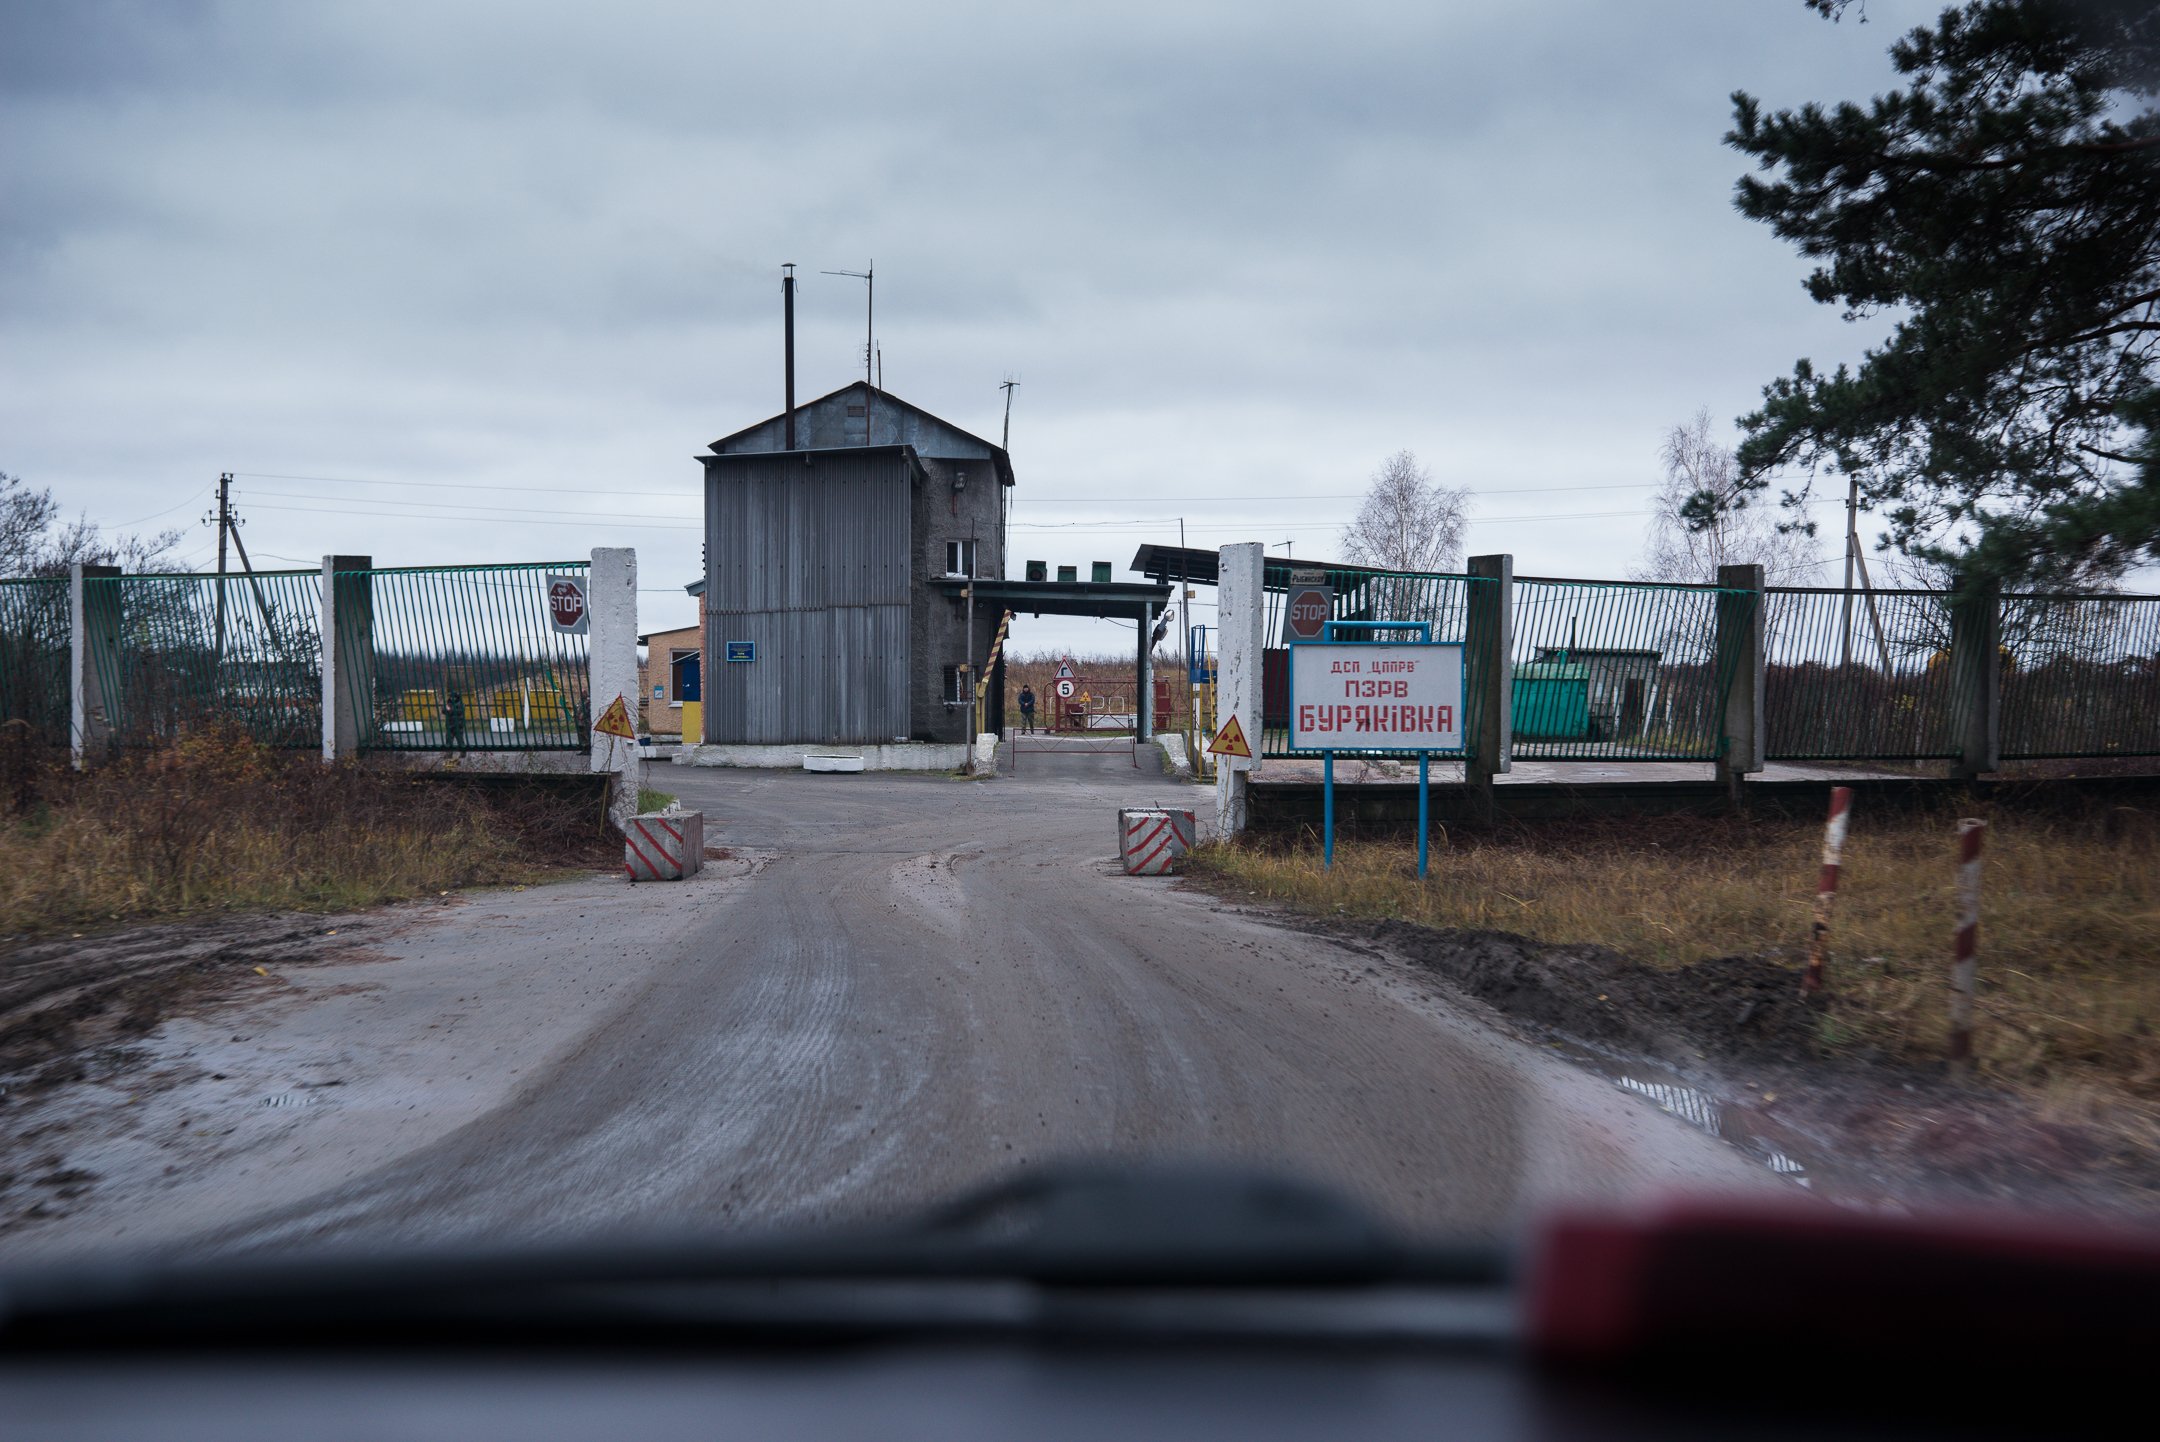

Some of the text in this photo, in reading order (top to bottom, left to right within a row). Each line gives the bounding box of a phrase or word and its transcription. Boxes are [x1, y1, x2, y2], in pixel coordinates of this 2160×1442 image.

[551, 595, 582, 612] STOP
[1292, 604, 1328, 620] STOP
[1331, 661, 1360, 674] ДСП
[1062, 684, 1070, 695] 5
[1345, 680, 1408, 698] ПЗРВ
[1299, 705, 1453, 733] БУРЯКІВКА
